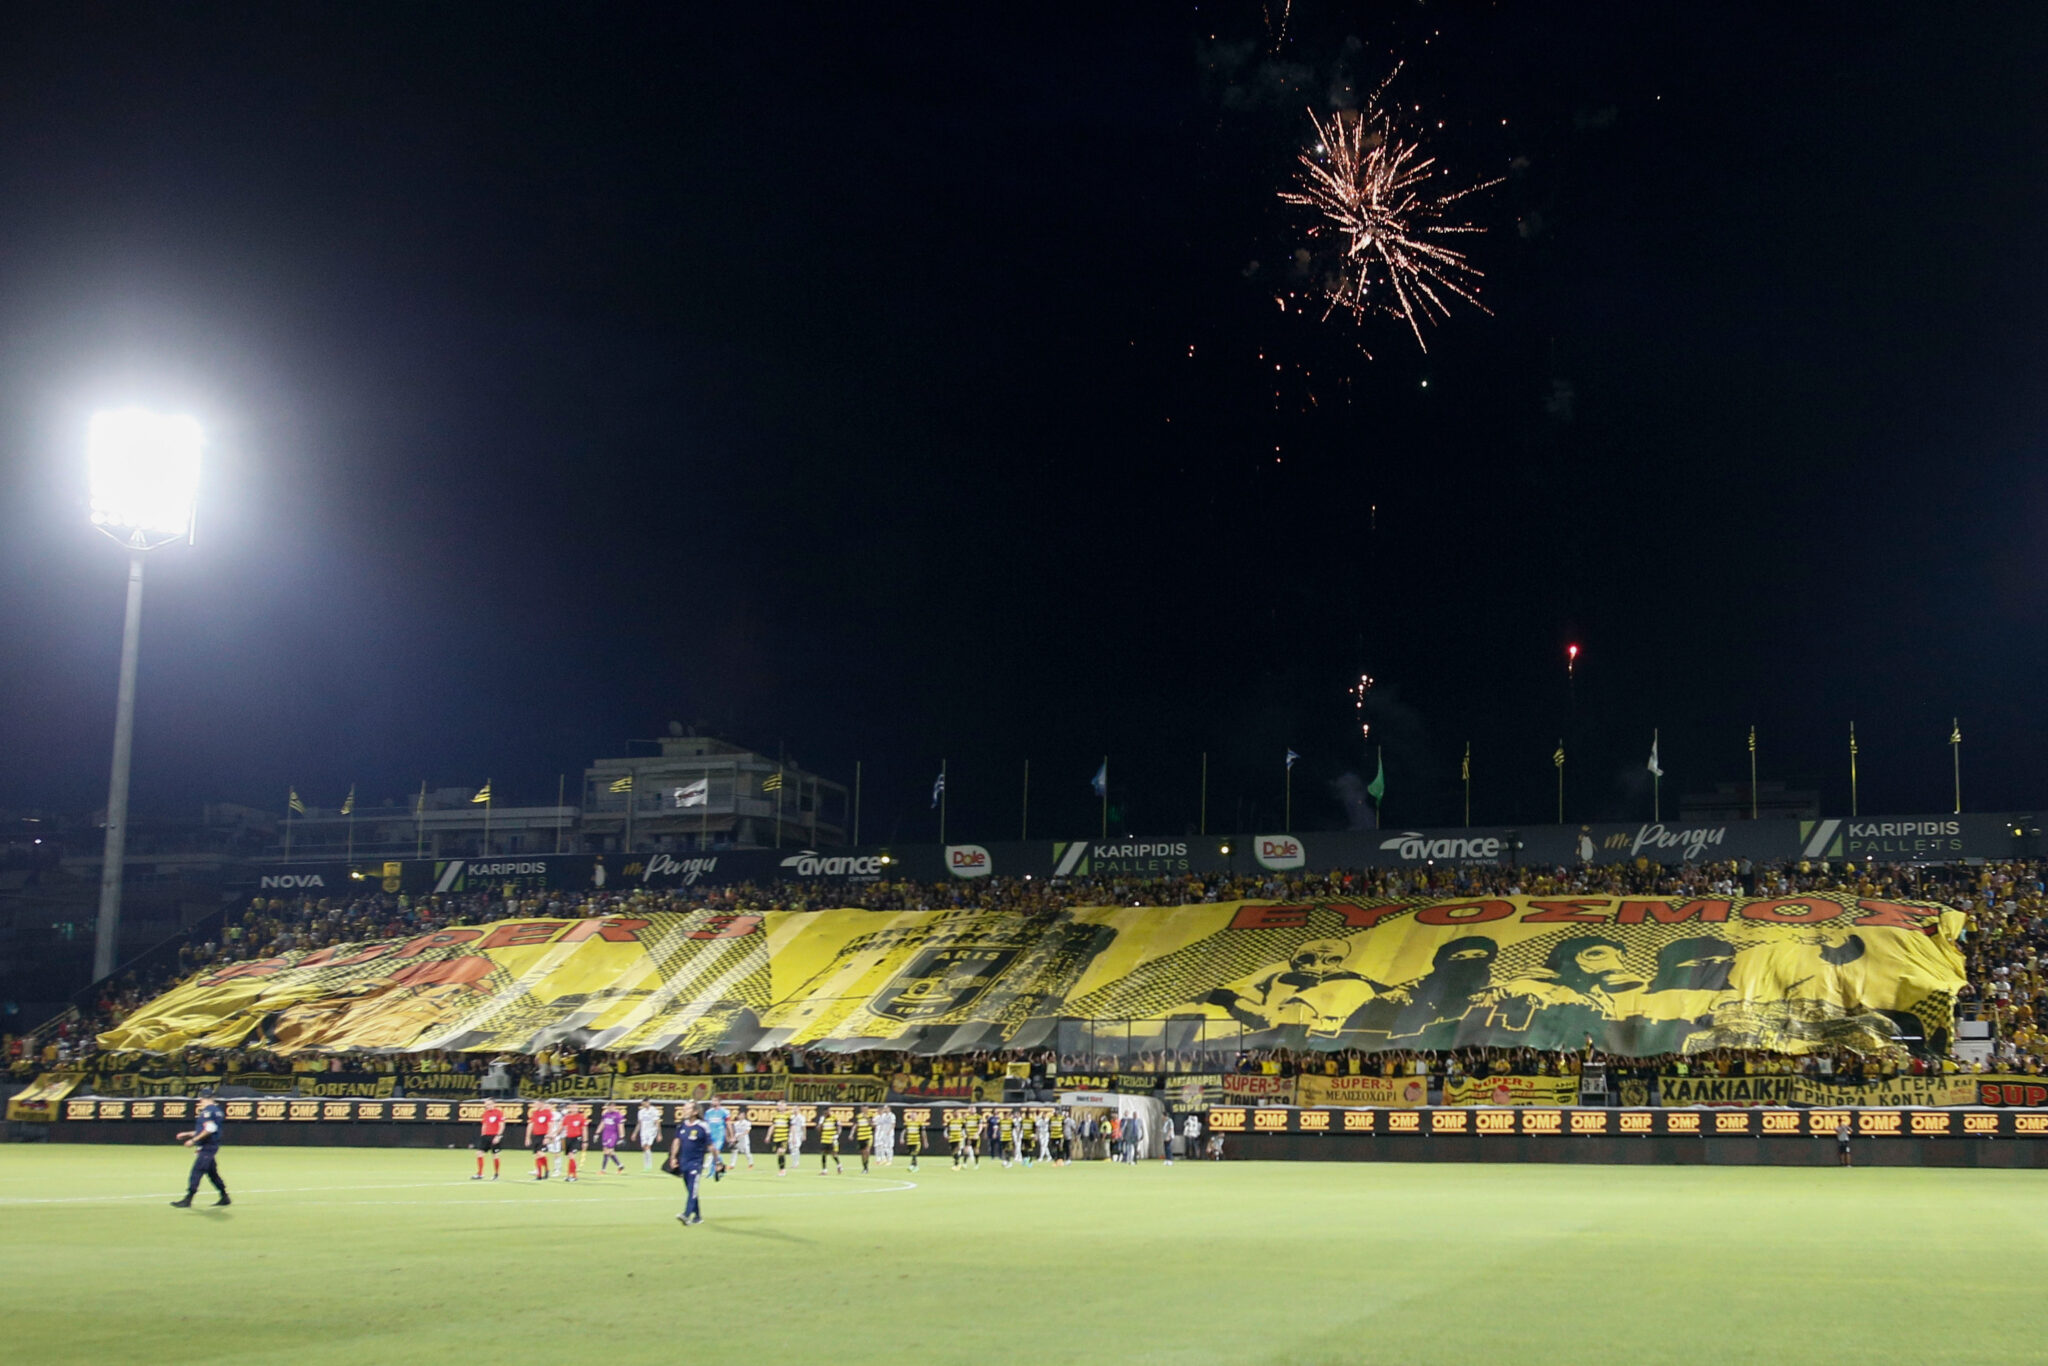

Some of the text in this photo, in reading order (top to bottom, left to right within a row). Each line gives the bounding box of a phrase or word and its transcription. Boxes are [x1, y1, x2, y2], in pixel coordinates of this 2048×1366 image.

[1849, 822, 1960, 837] KARIPIDIS
[1263, 841, 1298, 856] Dole
[1400, 838, 1499, 859] avance
[1630, 824, 1726, 860] Pengu
[1850, 839, 1962, 853] PALLETS
[953, 850, 985, 865] Dole
[1094, 843, 1187, 858] KARIPIDIS
[468, 862, 546, 875] KARIPIDIS
[642, 854, 717, 885] Pengu
[797, 854, 881, 876] avance
[1094, 859, 1189, 872] PALLETS
[260, 875, 324, 889] NOVA
[683, 915, 765, 941] 3
[935, 950, 1001, 961] ARIS
[633, 1082, 689, 1093] SUPER-3
[1056, 1075, 1109, 1088] PATRAS
[1331, 1078, 1394, 1089] SUPER-3
[1472, 1077, 1534, 1089] SUPER 3
[1901, 1077, 1947, 1092] ΓΕΡΑ
[315, 1083, 376, 1097] ORFANI
[1325, 1089, 1397, 1102] ΜΕΛΙΣΣΟΧΩΡΙ
[1662, 1079, 1789, 1101] ΧΑΛΚΙΔΙΚΗ
[1794, 1088, 1866, 1106] ΓΡΗΓΟΡΑ
[1879, 1093, 1936, 1106] ΚΟΝΤΑ
[1209, 1114, 1245, 1127] OMP
[1254, 1115, 1287, 1127] OMP
[1300, 1116, 1330, 1126] OMP
[1344, 1116, 1374, 1126] OMP
[1389, 1116, 1419, 1126] OMP
[1432, 1116, 1467, 1129] OMP
[1476, 1115, 1515, 1129] OMP
[1523, 1115, 1562, 1129] OMP
[1571, 1116, 1607, 1128] OMP
[1620, 1117, 1652, 1128] OMP
[1668, 1117, 1700, 1128] OMP
[1716, 1117, 1749, 1128] OMP
[1762, 1116, 1800, 1129] OMP
[1859, 1115, 1902, 1130] OMP
[1911, 1116, 1950, 1129] OMP
[1963, 1117, 1999, 1128] OMP
